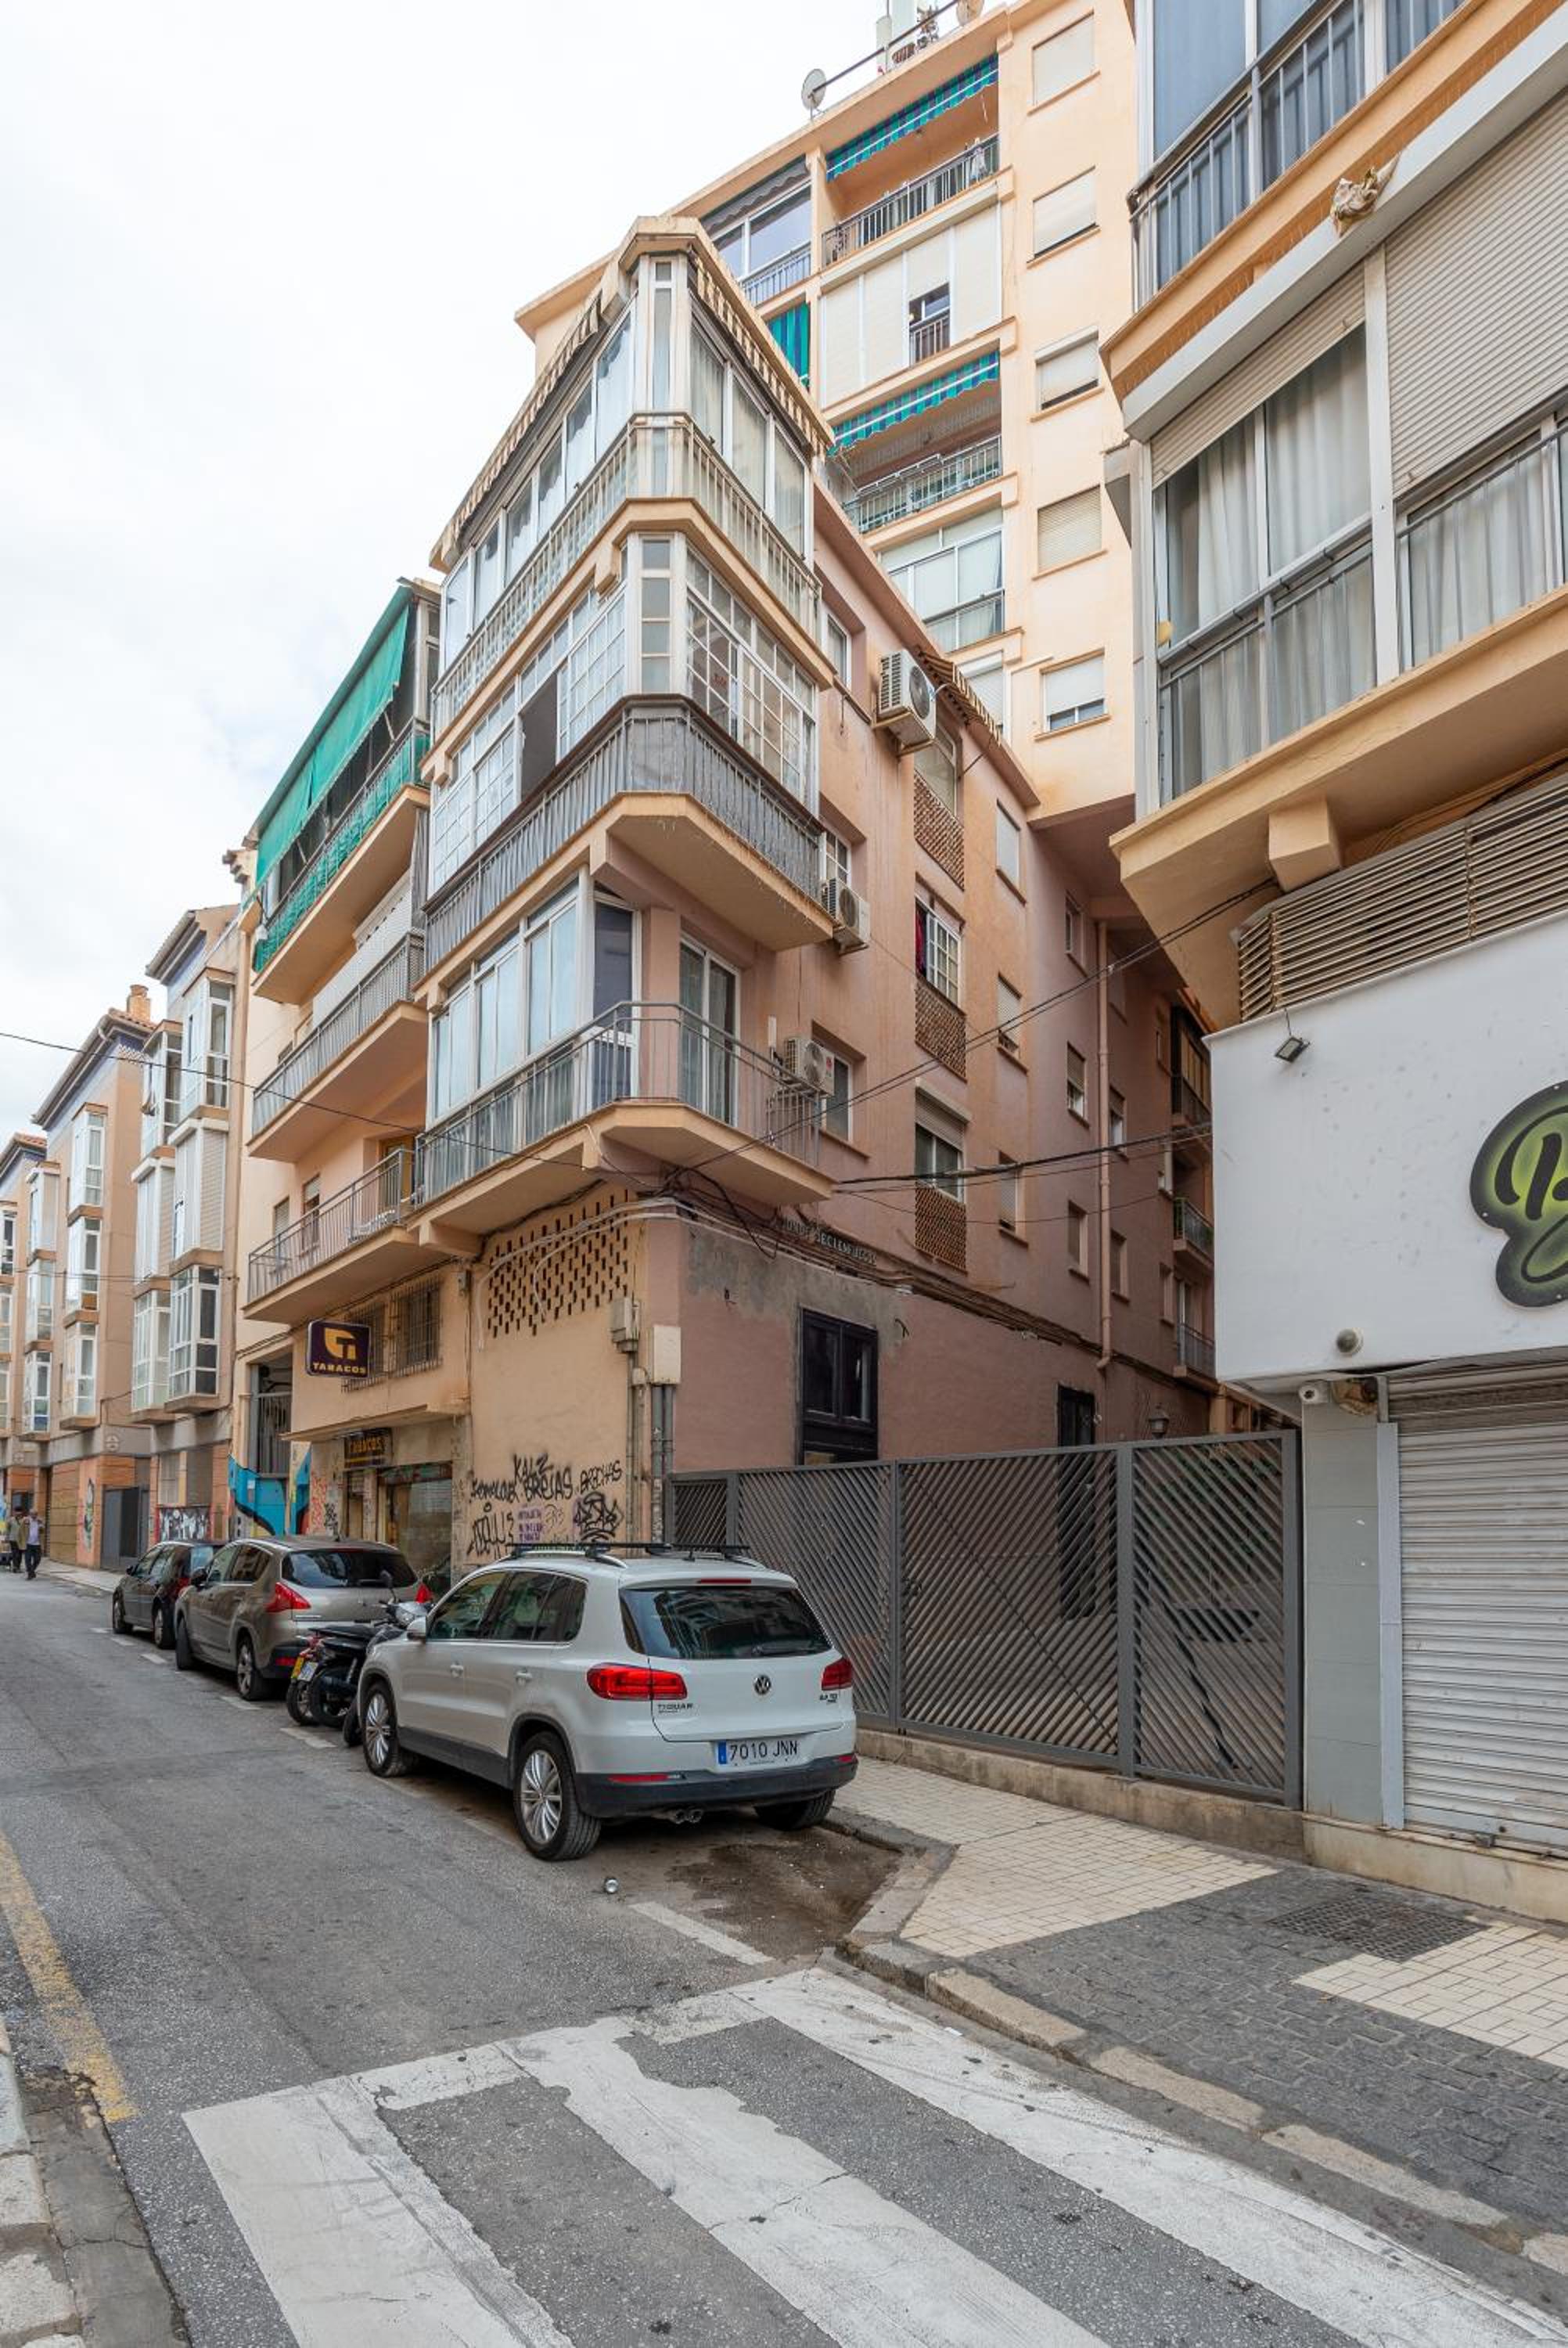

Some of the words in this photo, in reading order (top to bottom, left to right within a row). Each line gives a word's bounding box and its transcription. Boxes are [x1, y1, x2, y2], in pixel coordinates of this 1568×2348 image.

[313, 1362, 366, 1374] TABACOS
[729, 1741, 769, 1761] 7010
[773, 1740, 798, 1758] JNN
